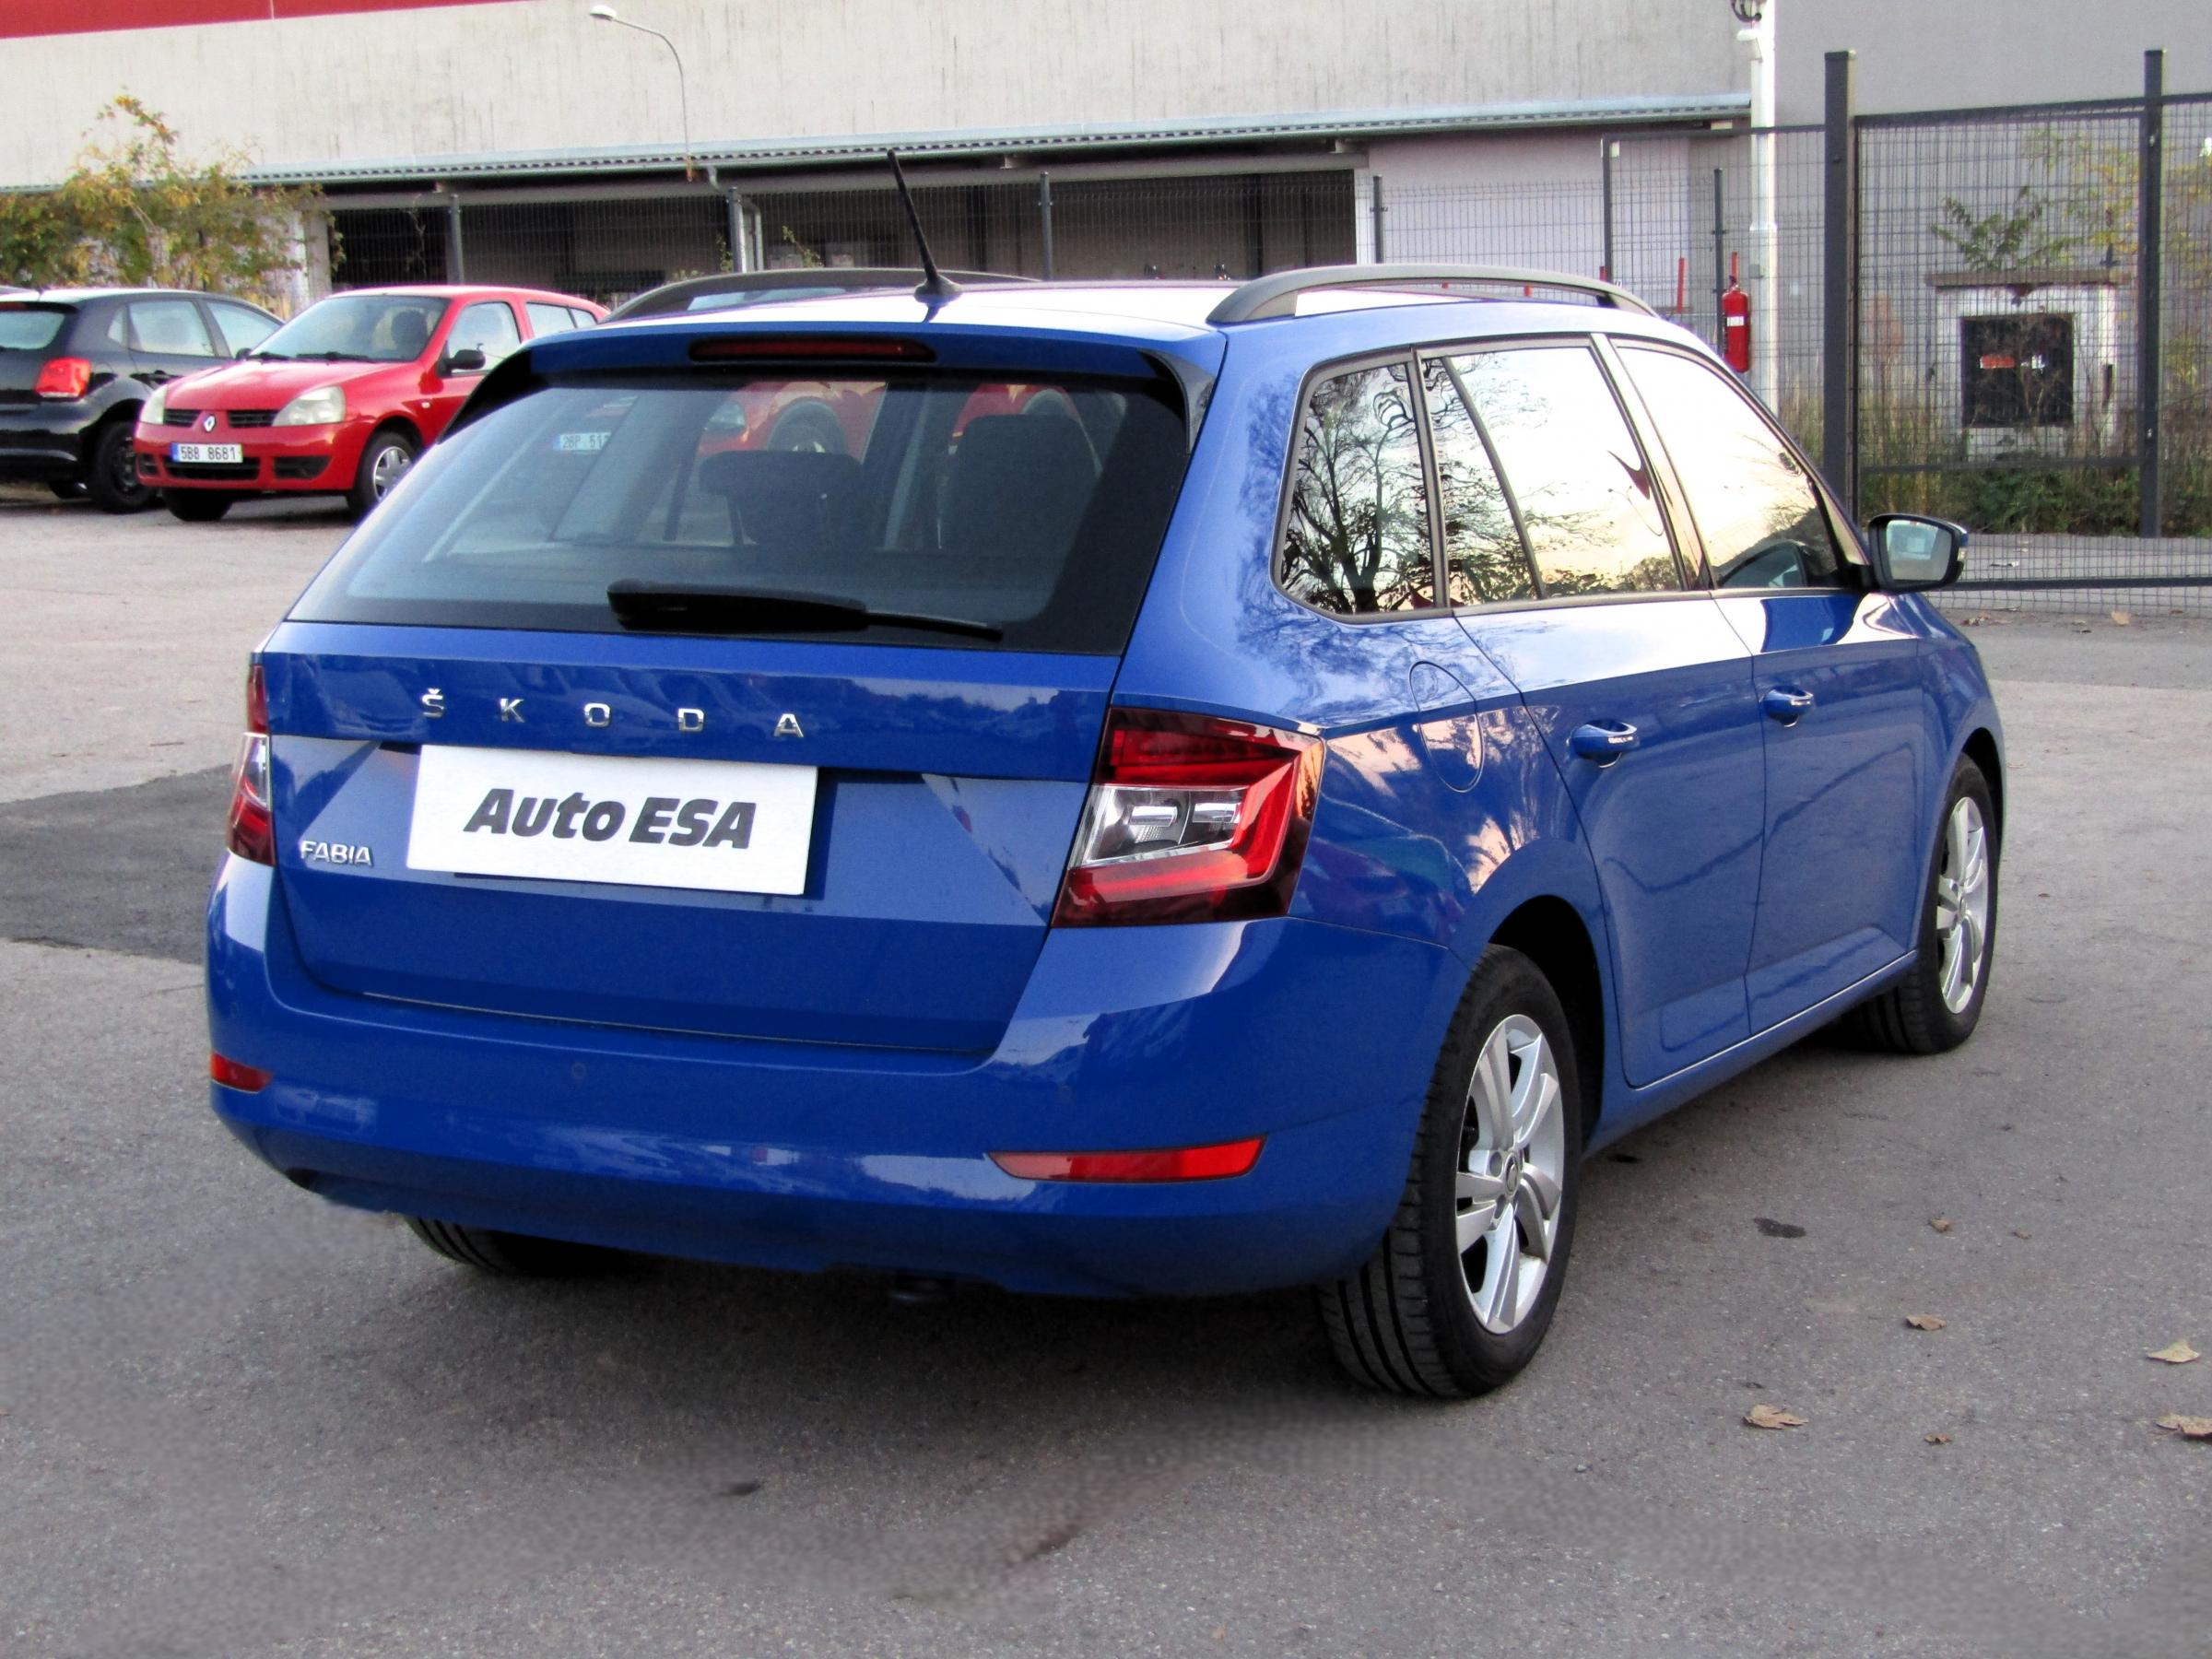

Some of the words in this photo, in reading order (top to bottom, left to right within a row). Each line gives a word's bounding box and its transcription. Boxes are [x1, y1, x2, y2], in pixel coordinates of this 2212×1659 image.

[207, 446, 236, 461] 8681
[421, 688, 805, 738] ŠKODA
[463, 788, 626, 841] Auto
[629, 796, 757, 850] ESA
[300, 840, 374, 867] FABIA
